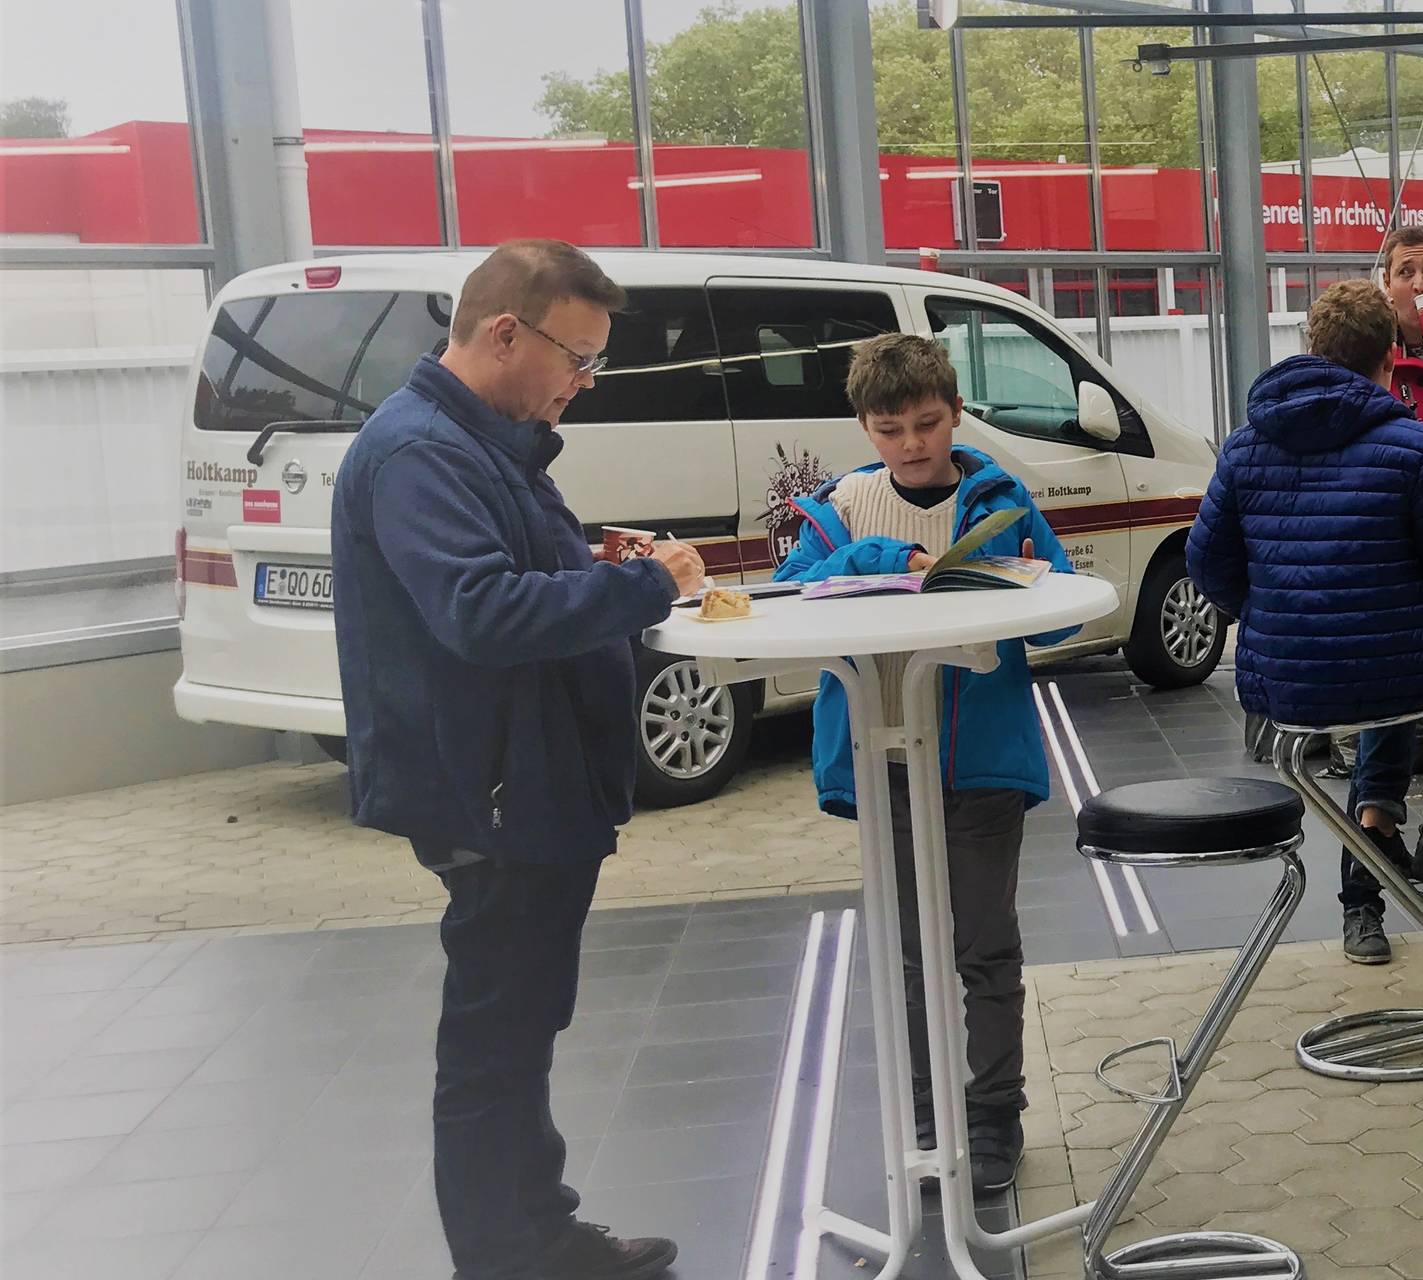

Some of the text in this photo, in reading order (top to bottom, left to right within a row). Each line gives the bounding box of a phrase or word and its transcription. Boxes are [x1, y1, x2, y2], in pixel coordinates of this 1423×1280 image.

[1263, 198, 1332, 225] enreien
[1335, 200, 1386, 233] richtig
[187, 461, 258, 488] Holtkamp
[1048, 486, 1092, 497] Holtkamp
[1085, 544, 1094, 555] 62
[1075, 560, 1094, 569] Essen
[267, 570, 278, 594] E
